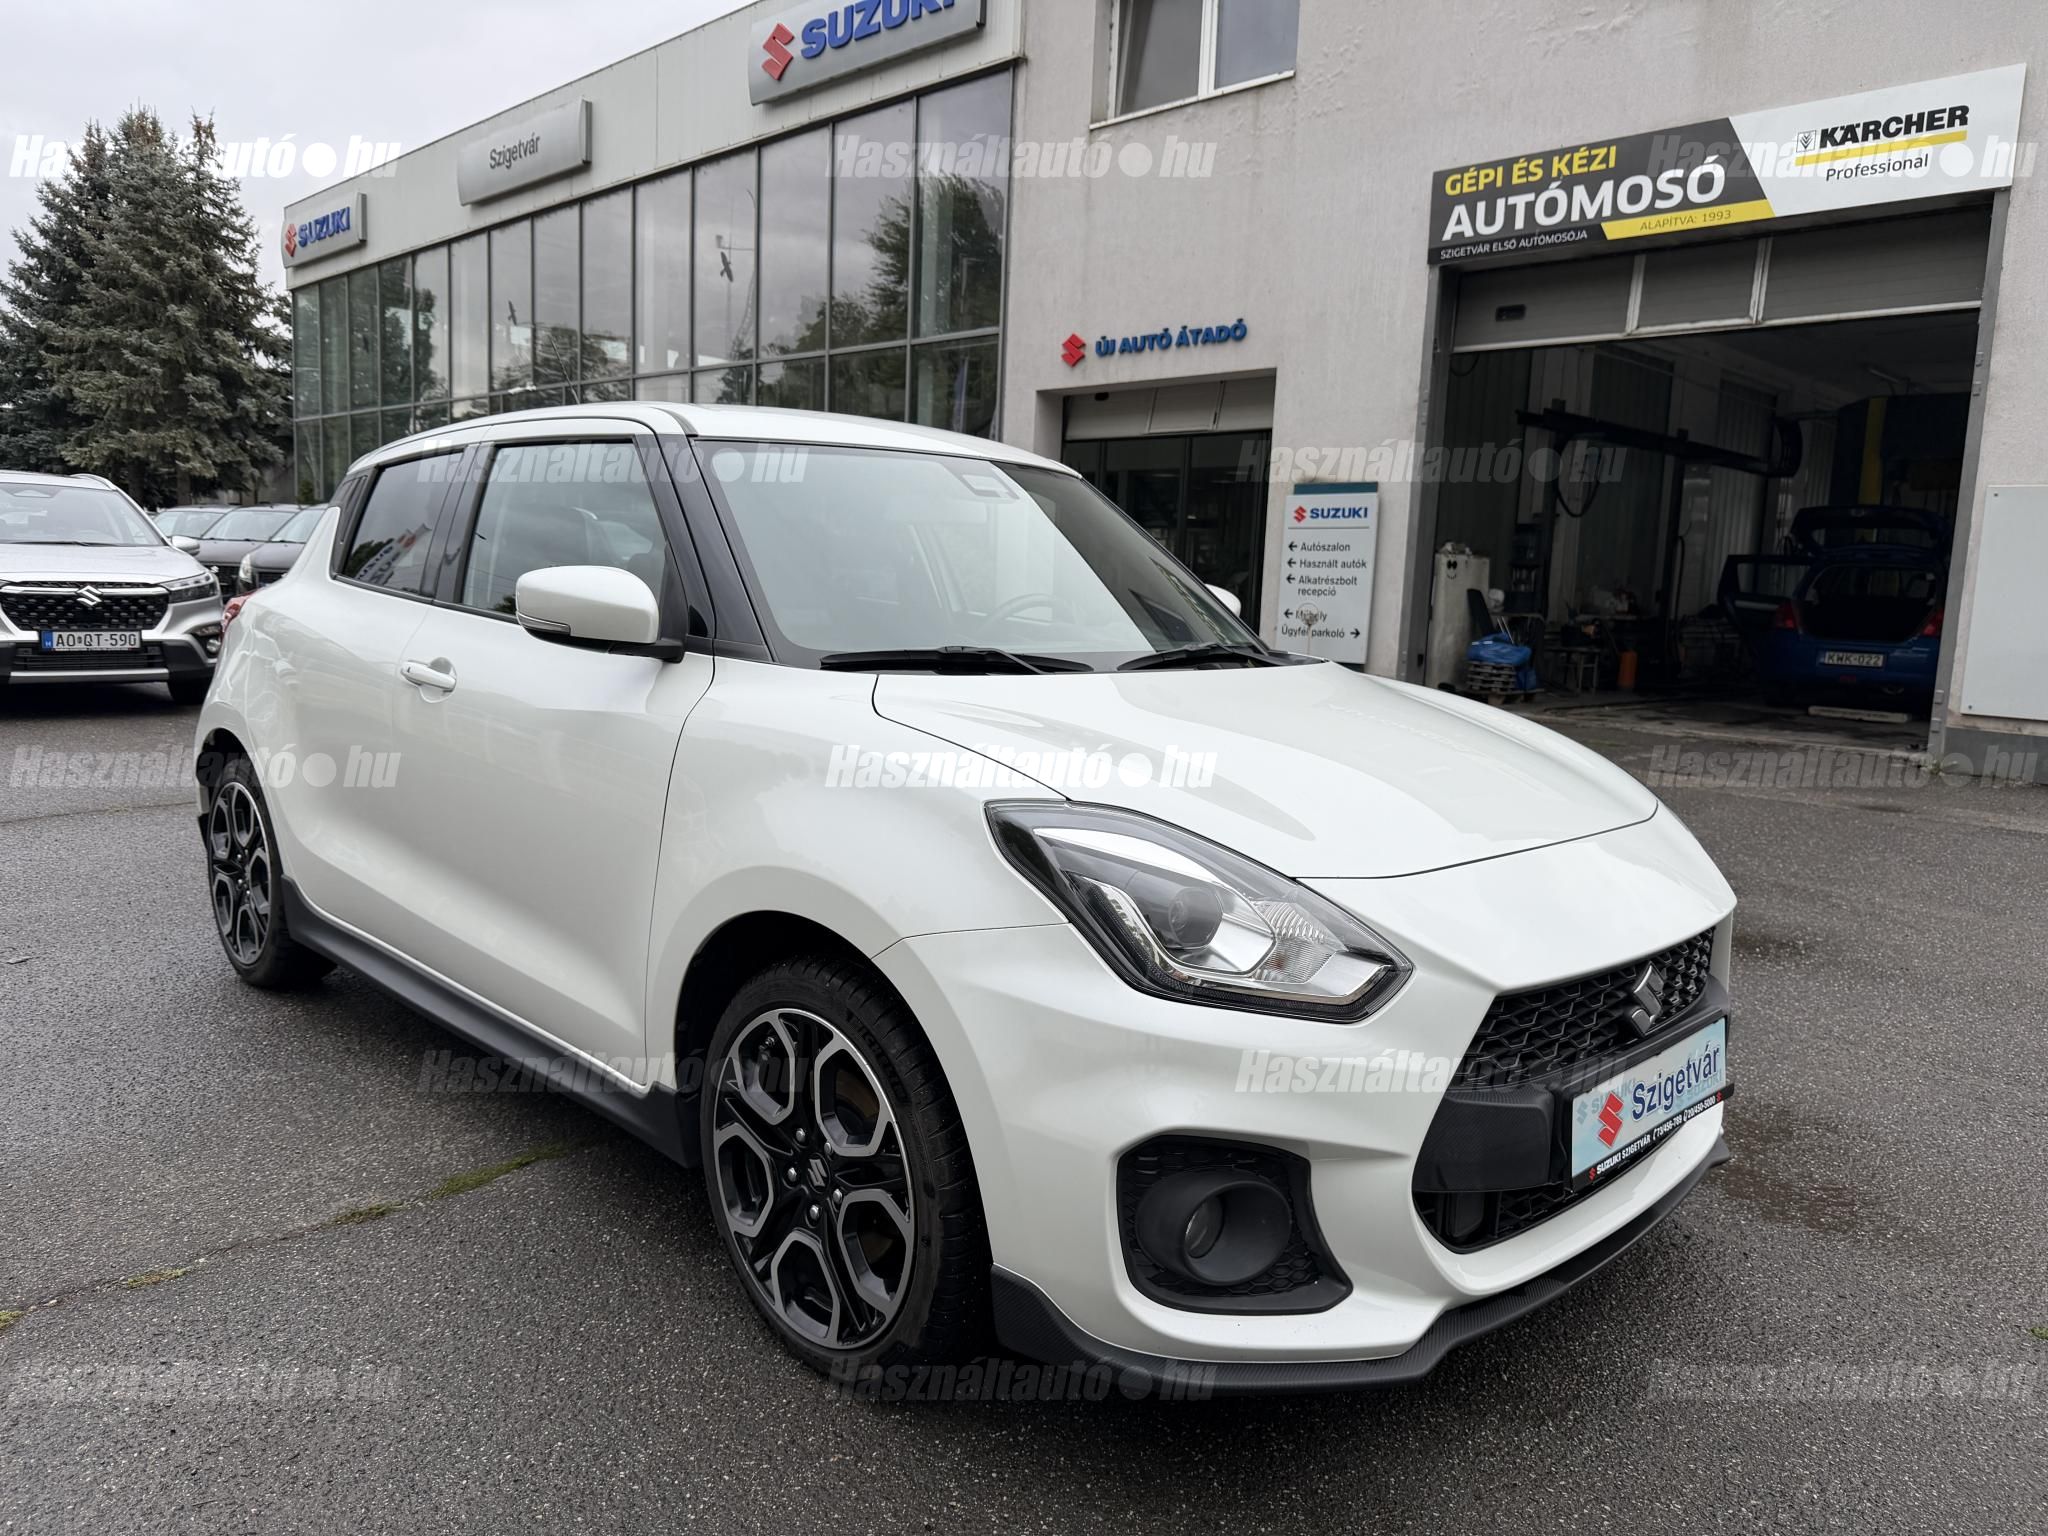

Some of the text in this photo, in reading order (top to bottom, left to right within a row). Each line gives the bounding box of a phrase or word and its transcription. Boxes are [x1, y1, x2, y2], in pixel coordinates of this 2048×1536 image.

[801, 0, 955, 59] SUZUK
[1819, 105, 1970, 149] KÄRCHER
[489, 133, 541, 170] Szigetvár
[1826, 153, 1929, 181] Professional
[1445, 145, 1617, 197] GÉPI ÉS KÉZI
[1441, 155, 1726, 242] AUTÓMOSÓ
[298, 206, 351, 248] SUZUKI
[1702, 209, 1732, 223] 1993
[1440, 243, 1491, 260] SZIGETVÁR
[1518, 230, 1588, 249] AUTÓMOSÓJA
[1095, 318, 1248, 357] ÚJ AUTÓ ÁTADÓ
[1310, 507, 1368, 519] SUZUKI
[1300, 542, 1351, 552] Autószalon
[1298, 575, 1358, 586] Alkatrészbolt
[1299, 559, 1367, 569] Használt autók
[1298, 586, 1337, 598] recepció
[1311, 627, 1345, 638] parkoló
[1632, 1041, 1720, 1121] Szigetvár
[1597, 1152, 1621, 1174] SUZUKI
[1622, 1133, 1651, 1159] SZIGETVÁR
